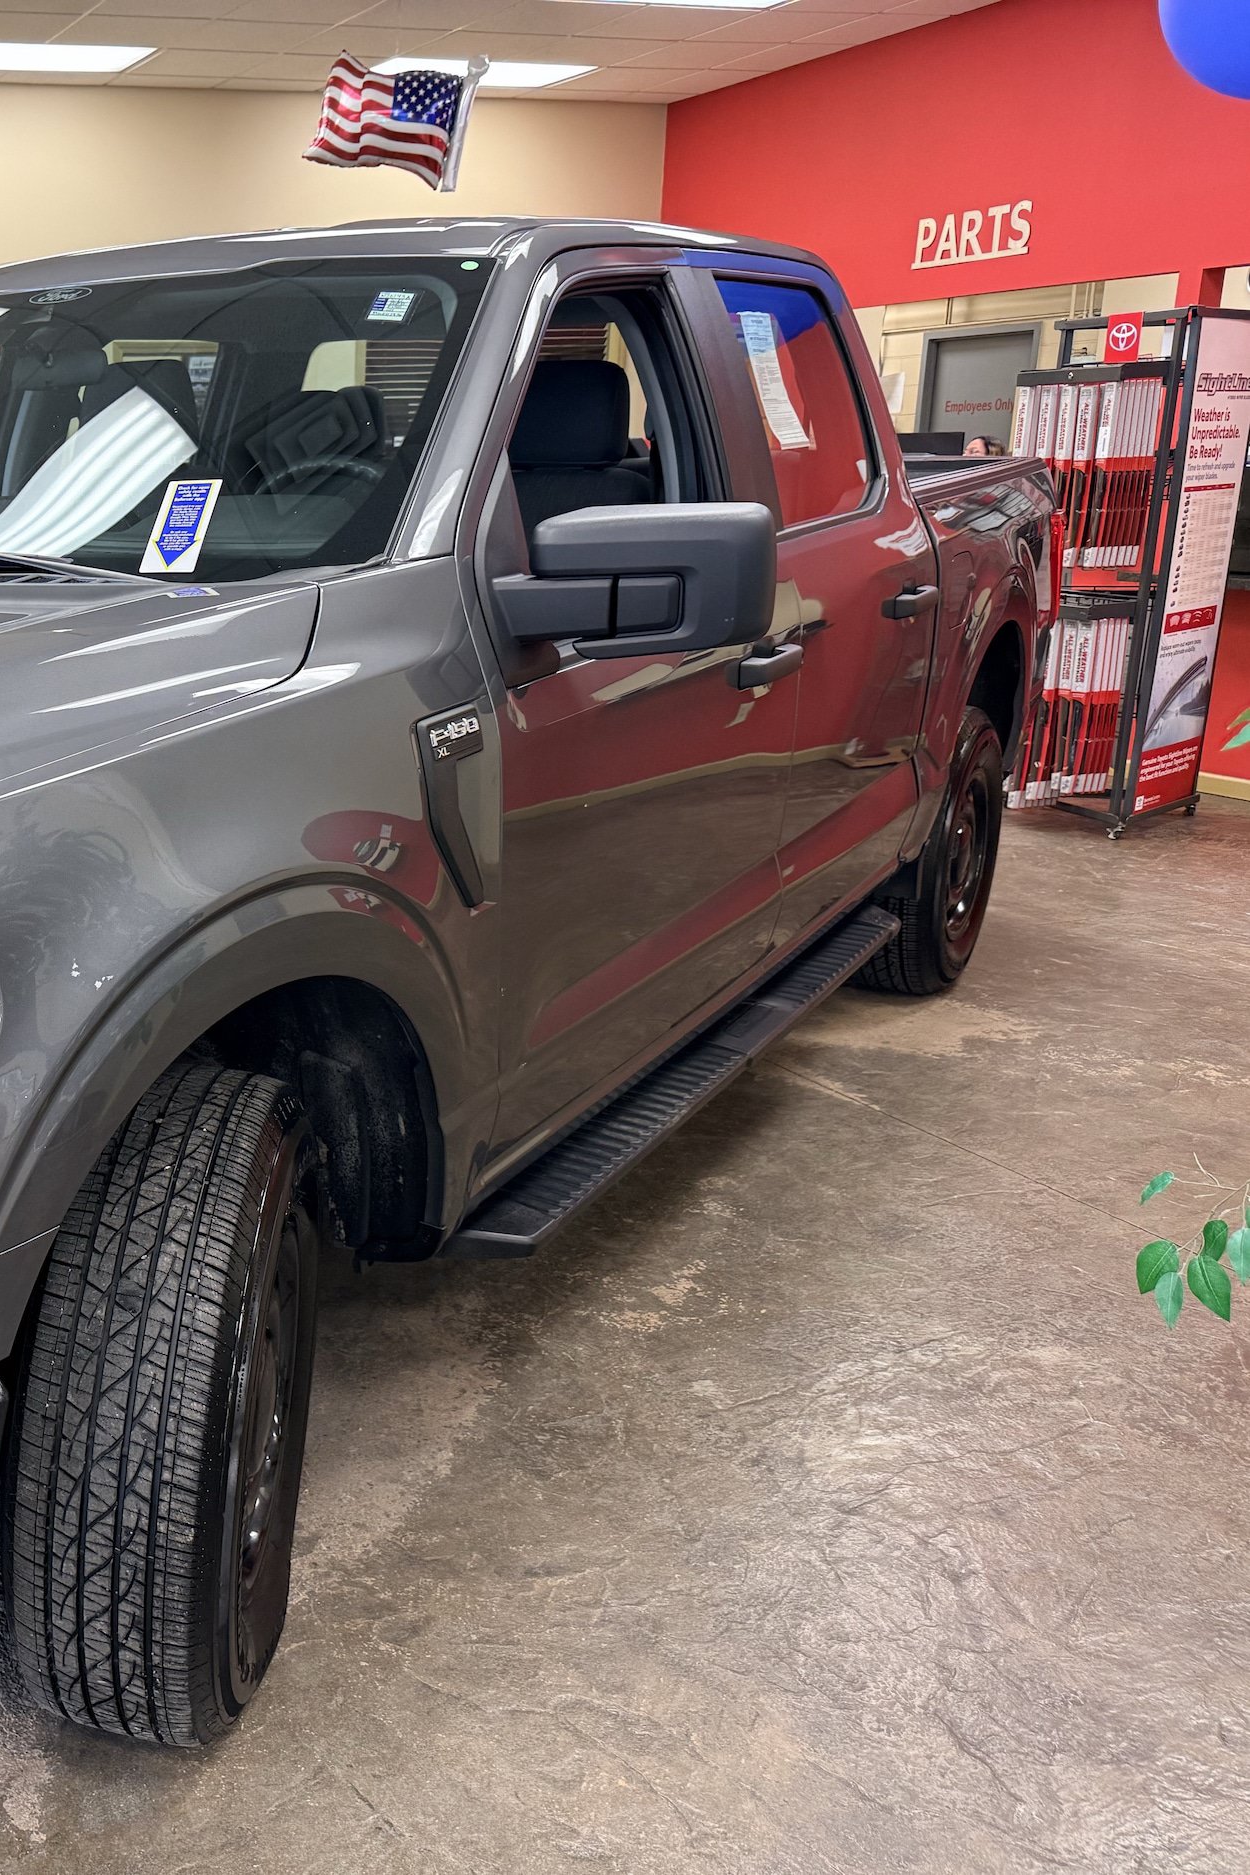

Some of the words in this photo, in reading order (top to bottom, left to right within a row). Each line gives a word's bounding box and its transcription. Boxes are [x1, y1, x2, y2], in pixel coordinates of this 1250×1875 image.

[913, 199, 1033, 267] PARTS
[945, 399, 993, 415] Employees
[1194, 407, 1224, 422] Weather
[1224, 407, 1231, 421] is
[1081, 402, 1090, 451] ALL-WEATHER
[1191, 424, 1241, 443] Unpredictable.
[1189, 445, 1198, 459] Be
[1199, 443, 1223, 461] Ready!
[430, 717, 480, 747] F-150
[437, 747, 450, 758] XL
